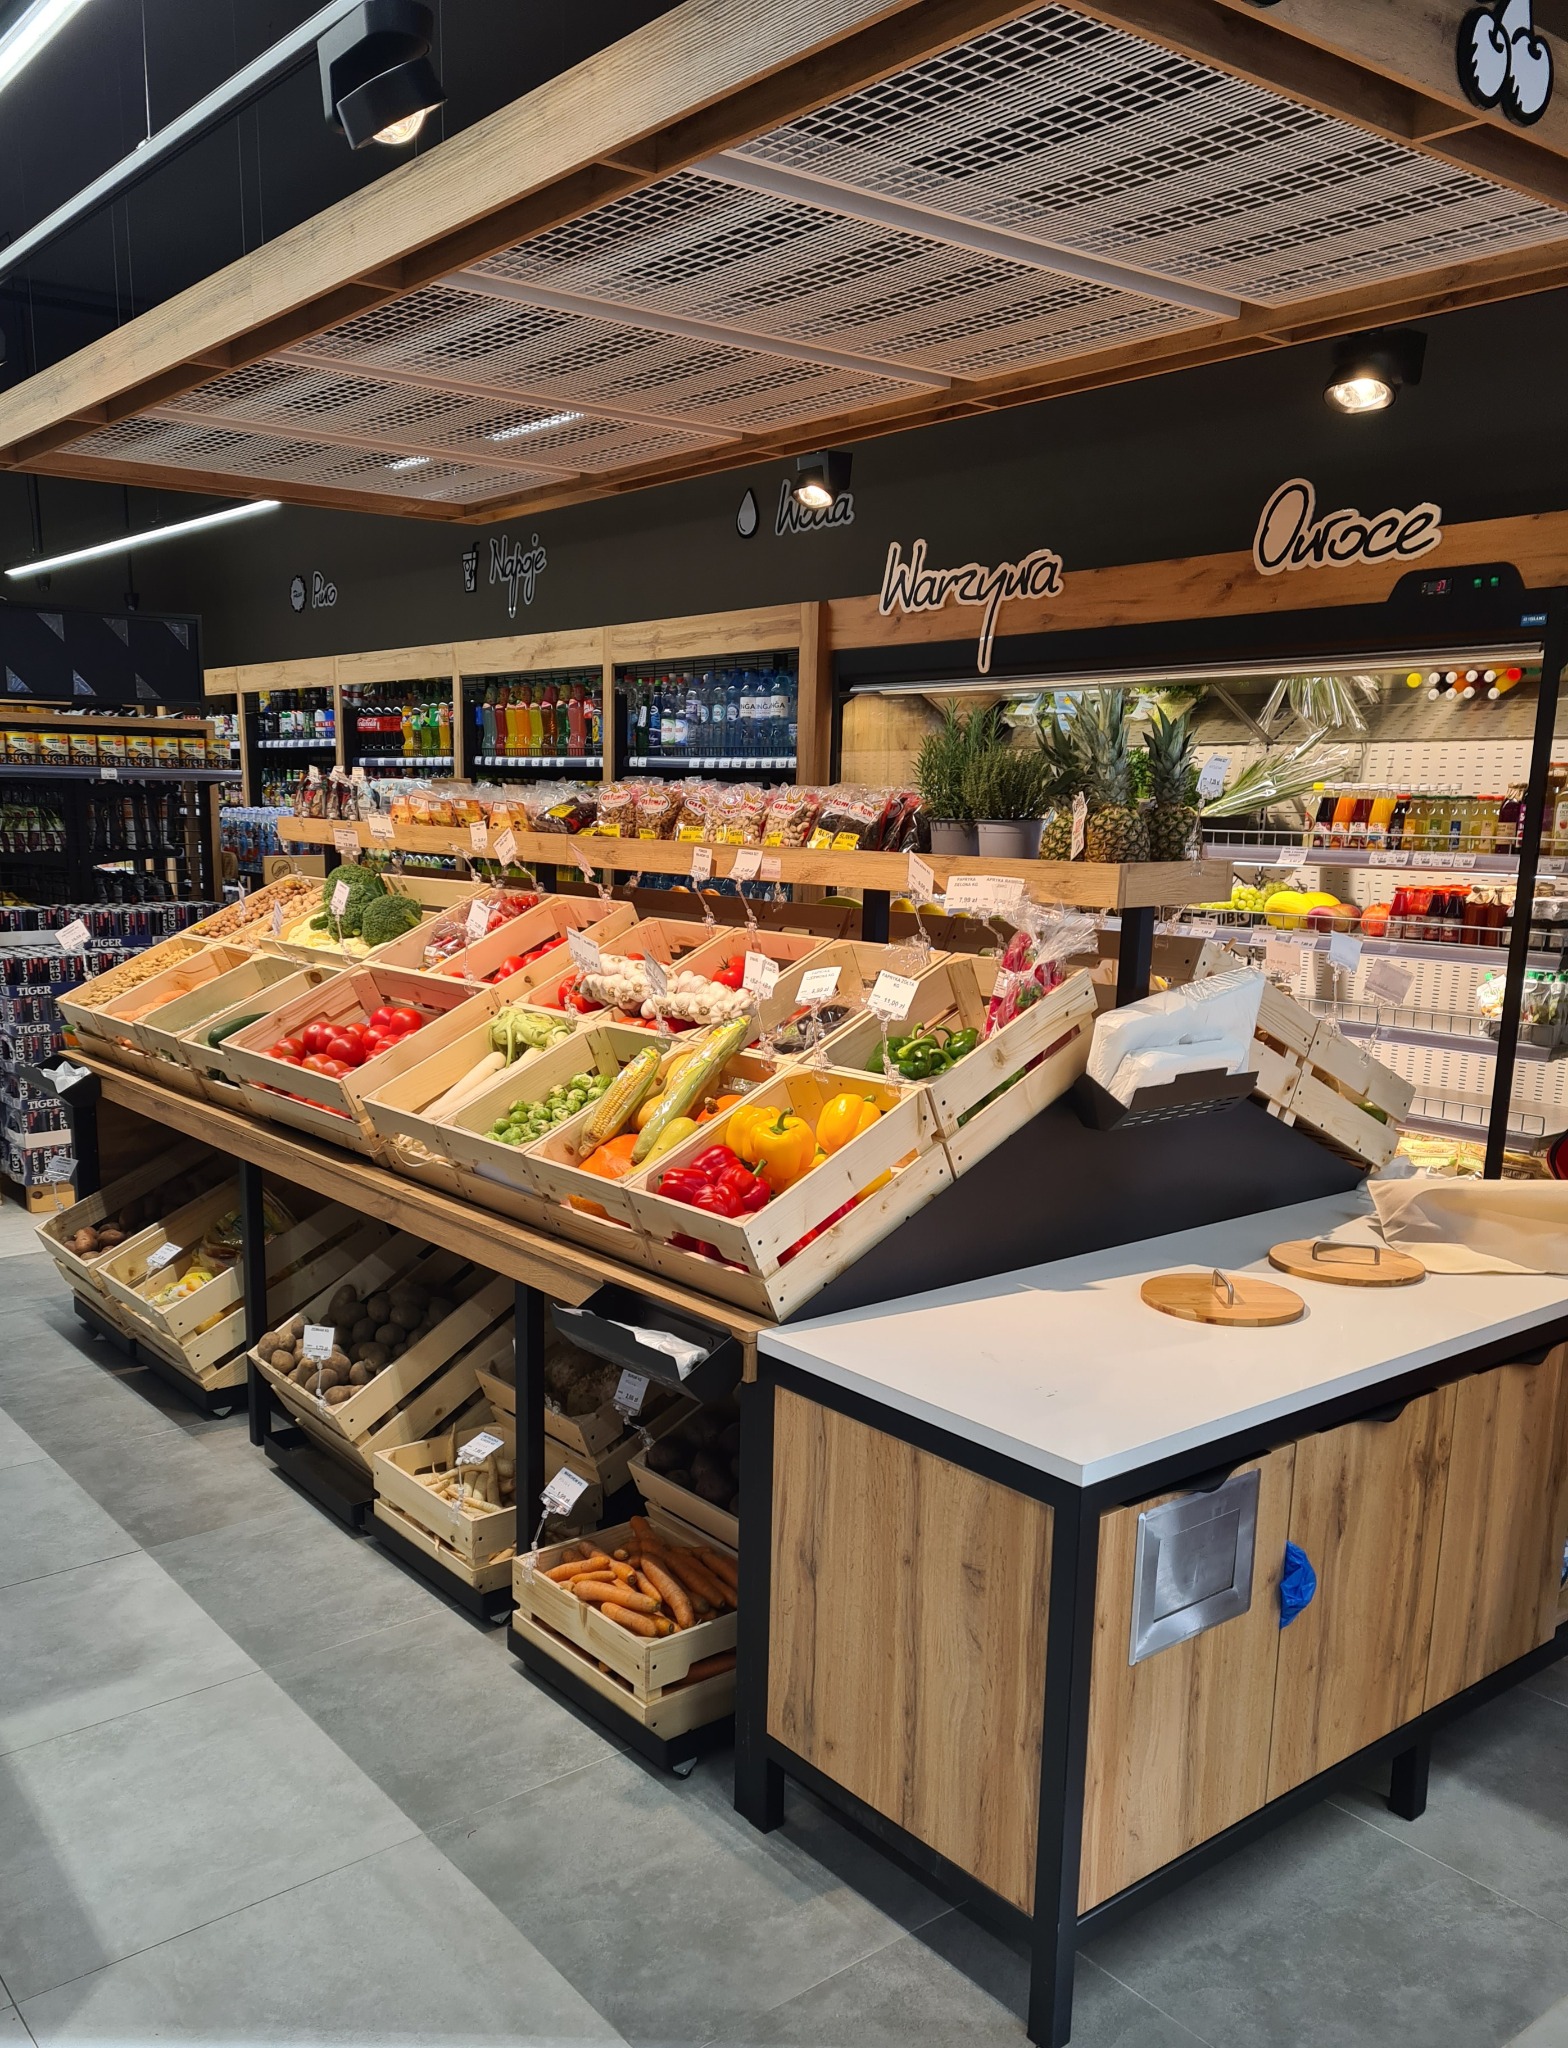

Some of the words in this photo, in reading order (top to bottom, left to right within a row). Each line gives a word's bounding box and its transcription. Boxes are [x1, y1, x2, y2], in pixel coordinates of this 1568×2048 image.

[1254, 479, 1443, 575] Owoce
[489, 533, 547, 618] Napoje
[879, 539, 1064, 673] Warzywa
[90, 938, 123, 948] TIGER
[882, 972, 901, 983] PAPRYKA
[16, 985, 52, 996] TIGER
[16, 1023, 51, 1035] TIGER
[27, 1098, 62, 1110] TIGER
